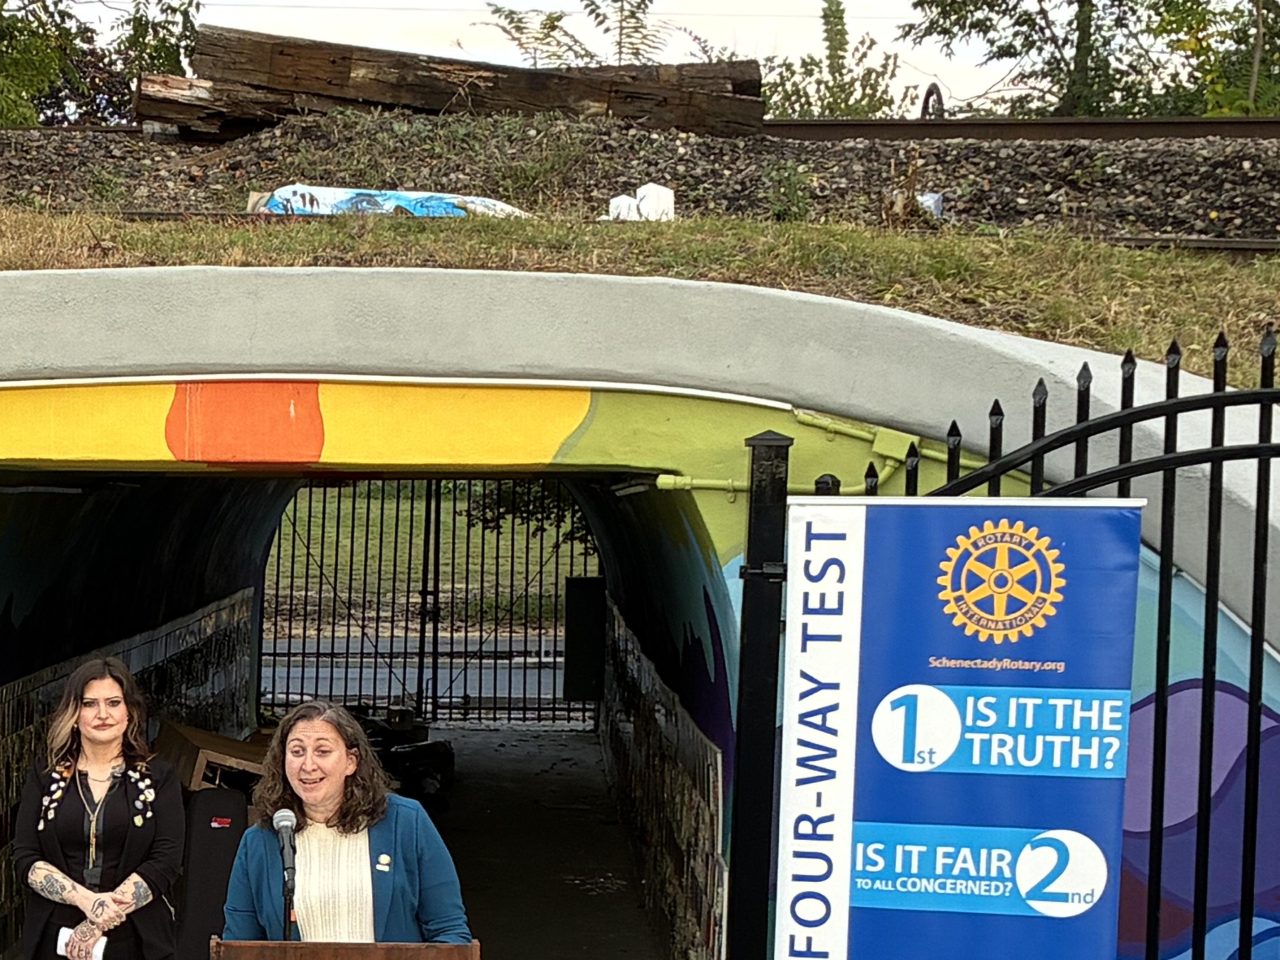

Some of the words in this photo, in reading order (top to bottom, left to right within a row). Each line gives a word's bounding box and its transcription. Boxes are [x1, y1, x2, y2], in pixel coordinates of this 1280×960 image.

[977, 533, 1029, 547] ROTARY
[800, 521, 847, 652] TEST
[958, 599, 1047, 629] INTERNATIONAL
[928, 656, 1065, 673] SchenectadyRotary.org
[889, 694, 936, 764] 1st
[966, 696, 997, 727] IS
[1008, 697, 1043, 729] IT
[1048, 699, 1124, 731] THE
[964, 733, 1120, 770] TRUTH?
[789, 669, 840, 959] FOUR-WAY
[855, 843, 885, 873] IS
[895, 845, 927, 874] IT
[935, 847, 1012, 878] FAIR
[1025, 836, 1095, 904] 2nd
[855, 878, 872, 890] TO
[873, 880, 895, 891] ALL
[896, 877, 1013, 897] CONCERNED?
